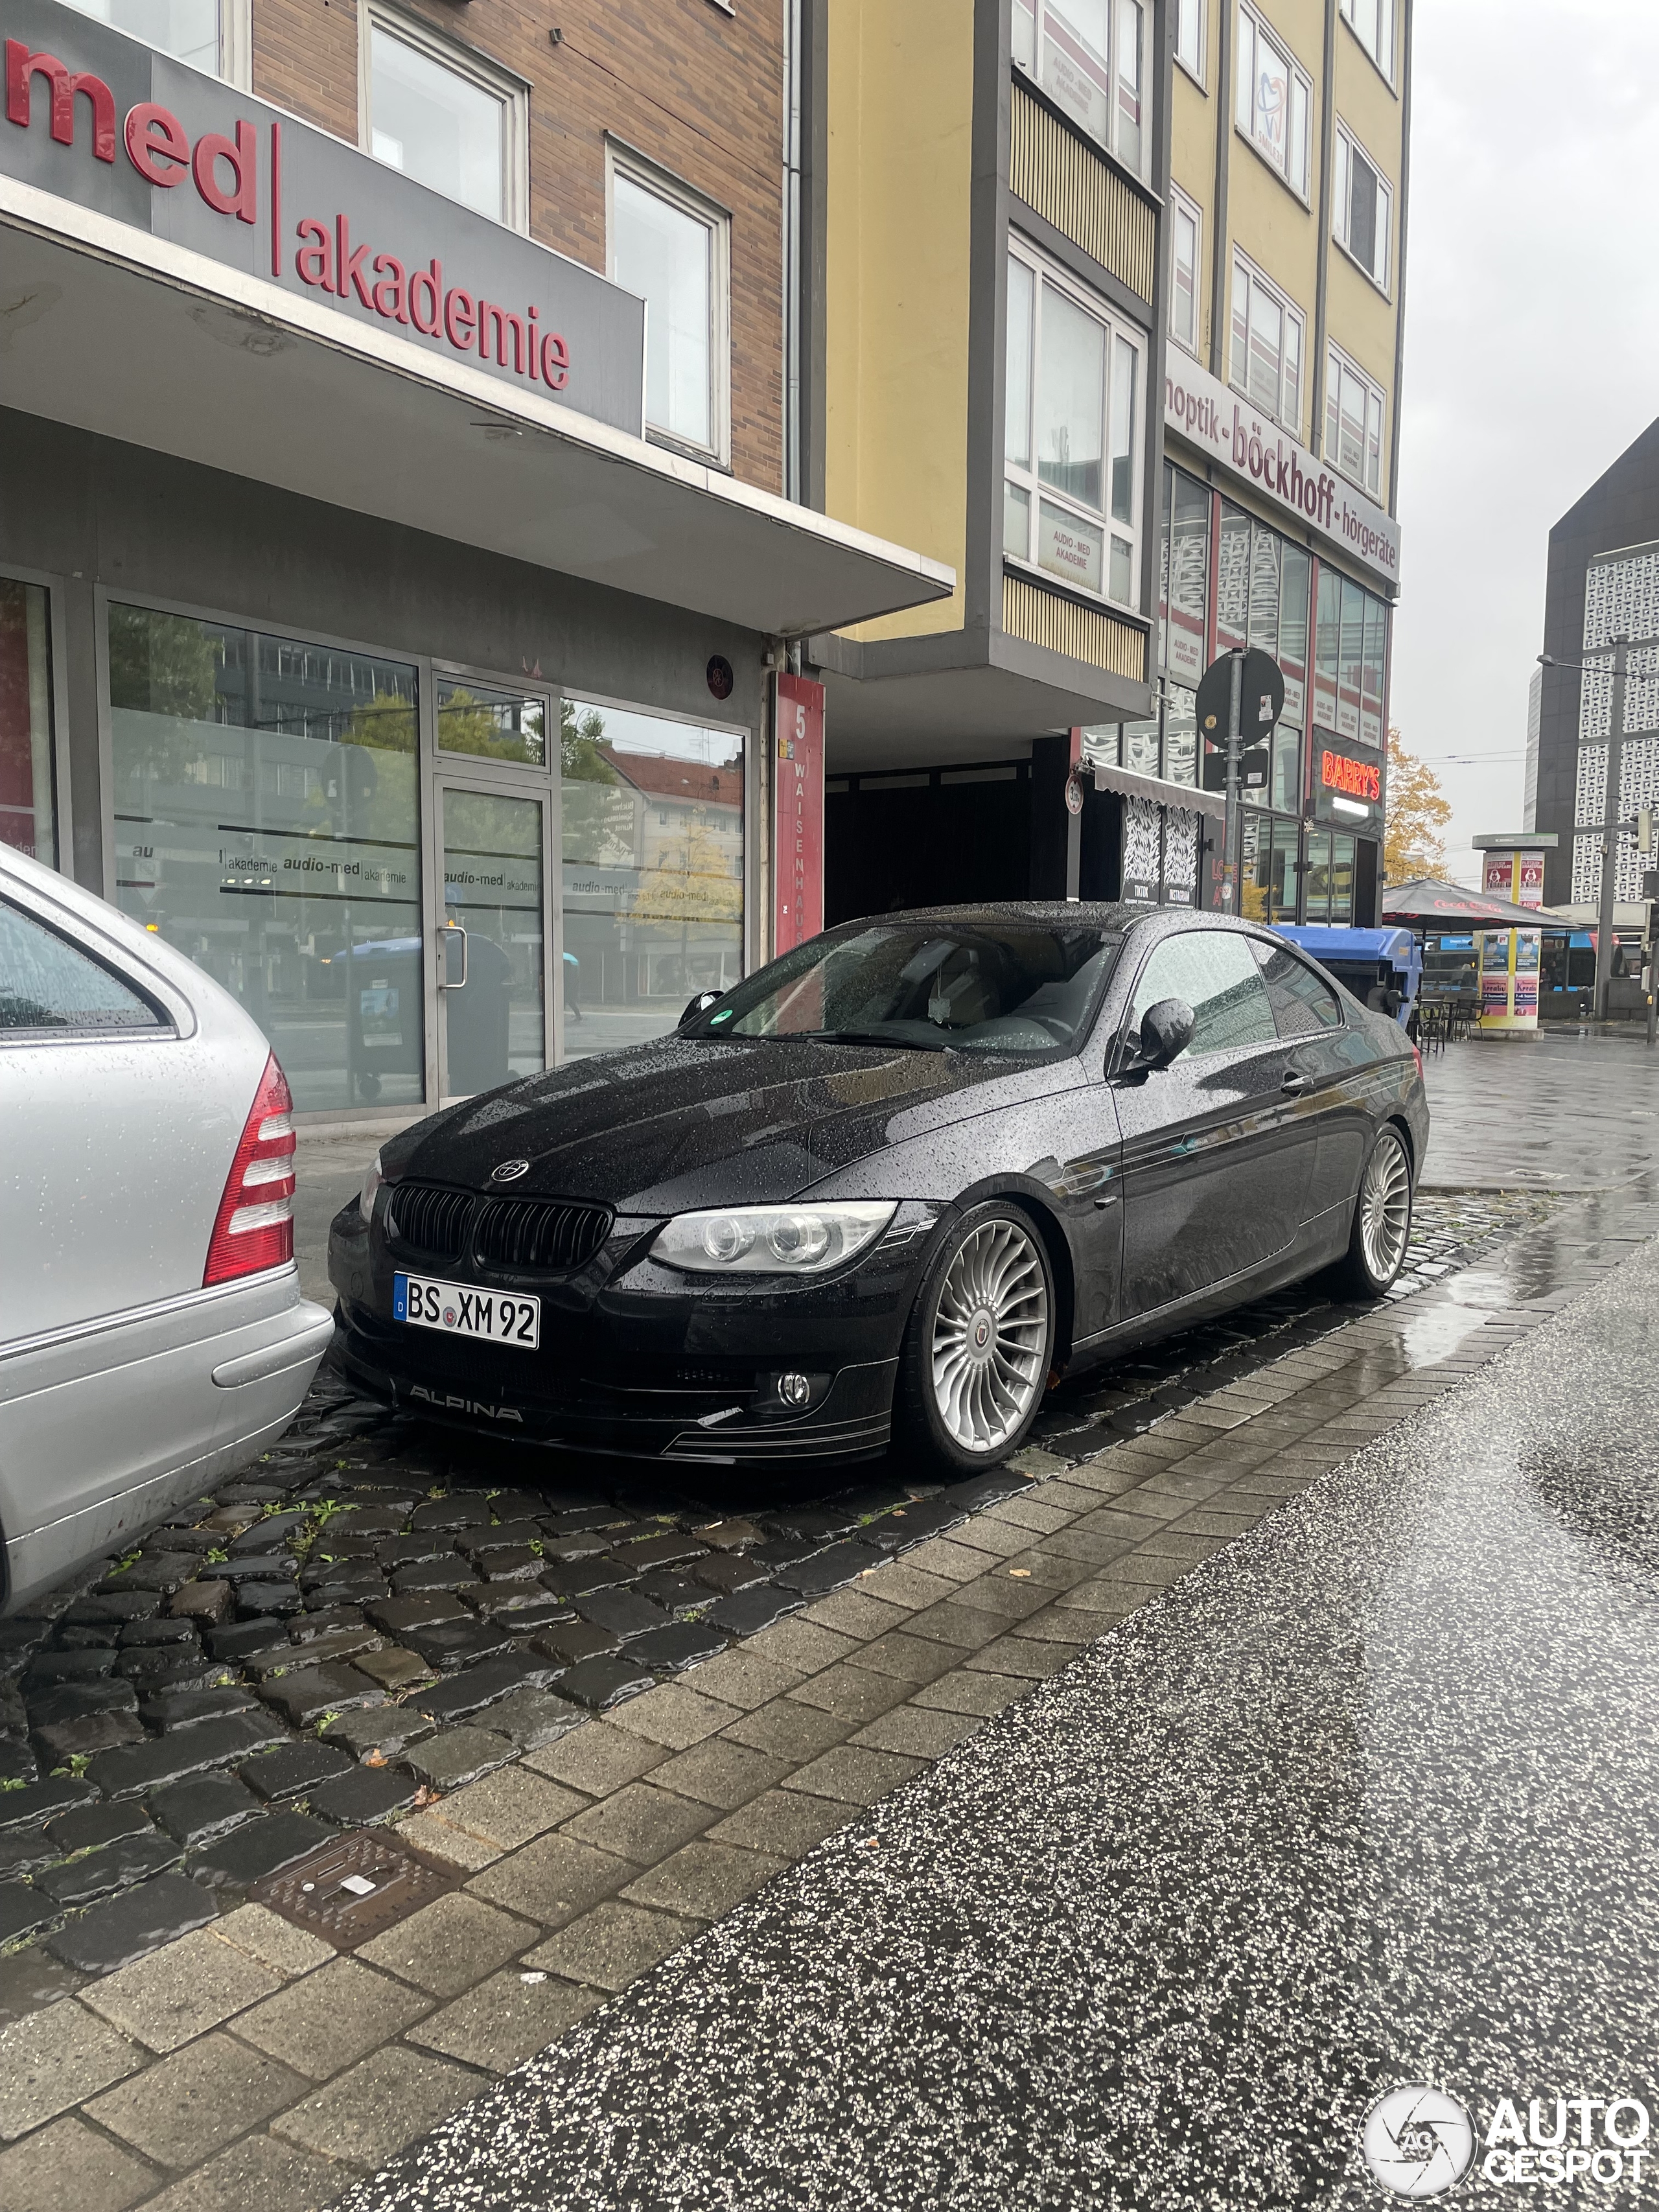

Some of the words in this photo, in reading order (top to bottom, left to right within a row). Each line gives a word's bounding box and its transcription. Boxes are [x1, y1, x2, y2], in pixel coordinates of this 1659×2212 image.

[6, 39, 257, 225] med
[295, 214, 570, 391] akademie
[1233, 404, 1335, 528] böckhoff
[1343, 501, 1395, 568] hörgeräte
[1053, 530, 1073, 548] AUDIO
[1077, 541, 1091, 556] MED
[1056, 546, 1087, 570] AKADEMIE
[1174, 639, 1187, 651] AUDIO
[1190, 646, 1199, 657] MED
[1176, 651, 1197, 667] AKADEMIE
[796, 704, 806, 739] 5
[1321, 750, 1380, 801] BARRY'S
[228, 858, 277, 873] akademie
[283, 857, 360, 875] audio-med
[444, 871, 503, 886] audio-med
[398, 1301, 403, 1312] D
[408, 1282, 439, 1322] BS
[458, 1292, 493, 1334] XM
[500, 1300, 535, 1342] 92
[410, 1384, 524, 1423] ALPINA
